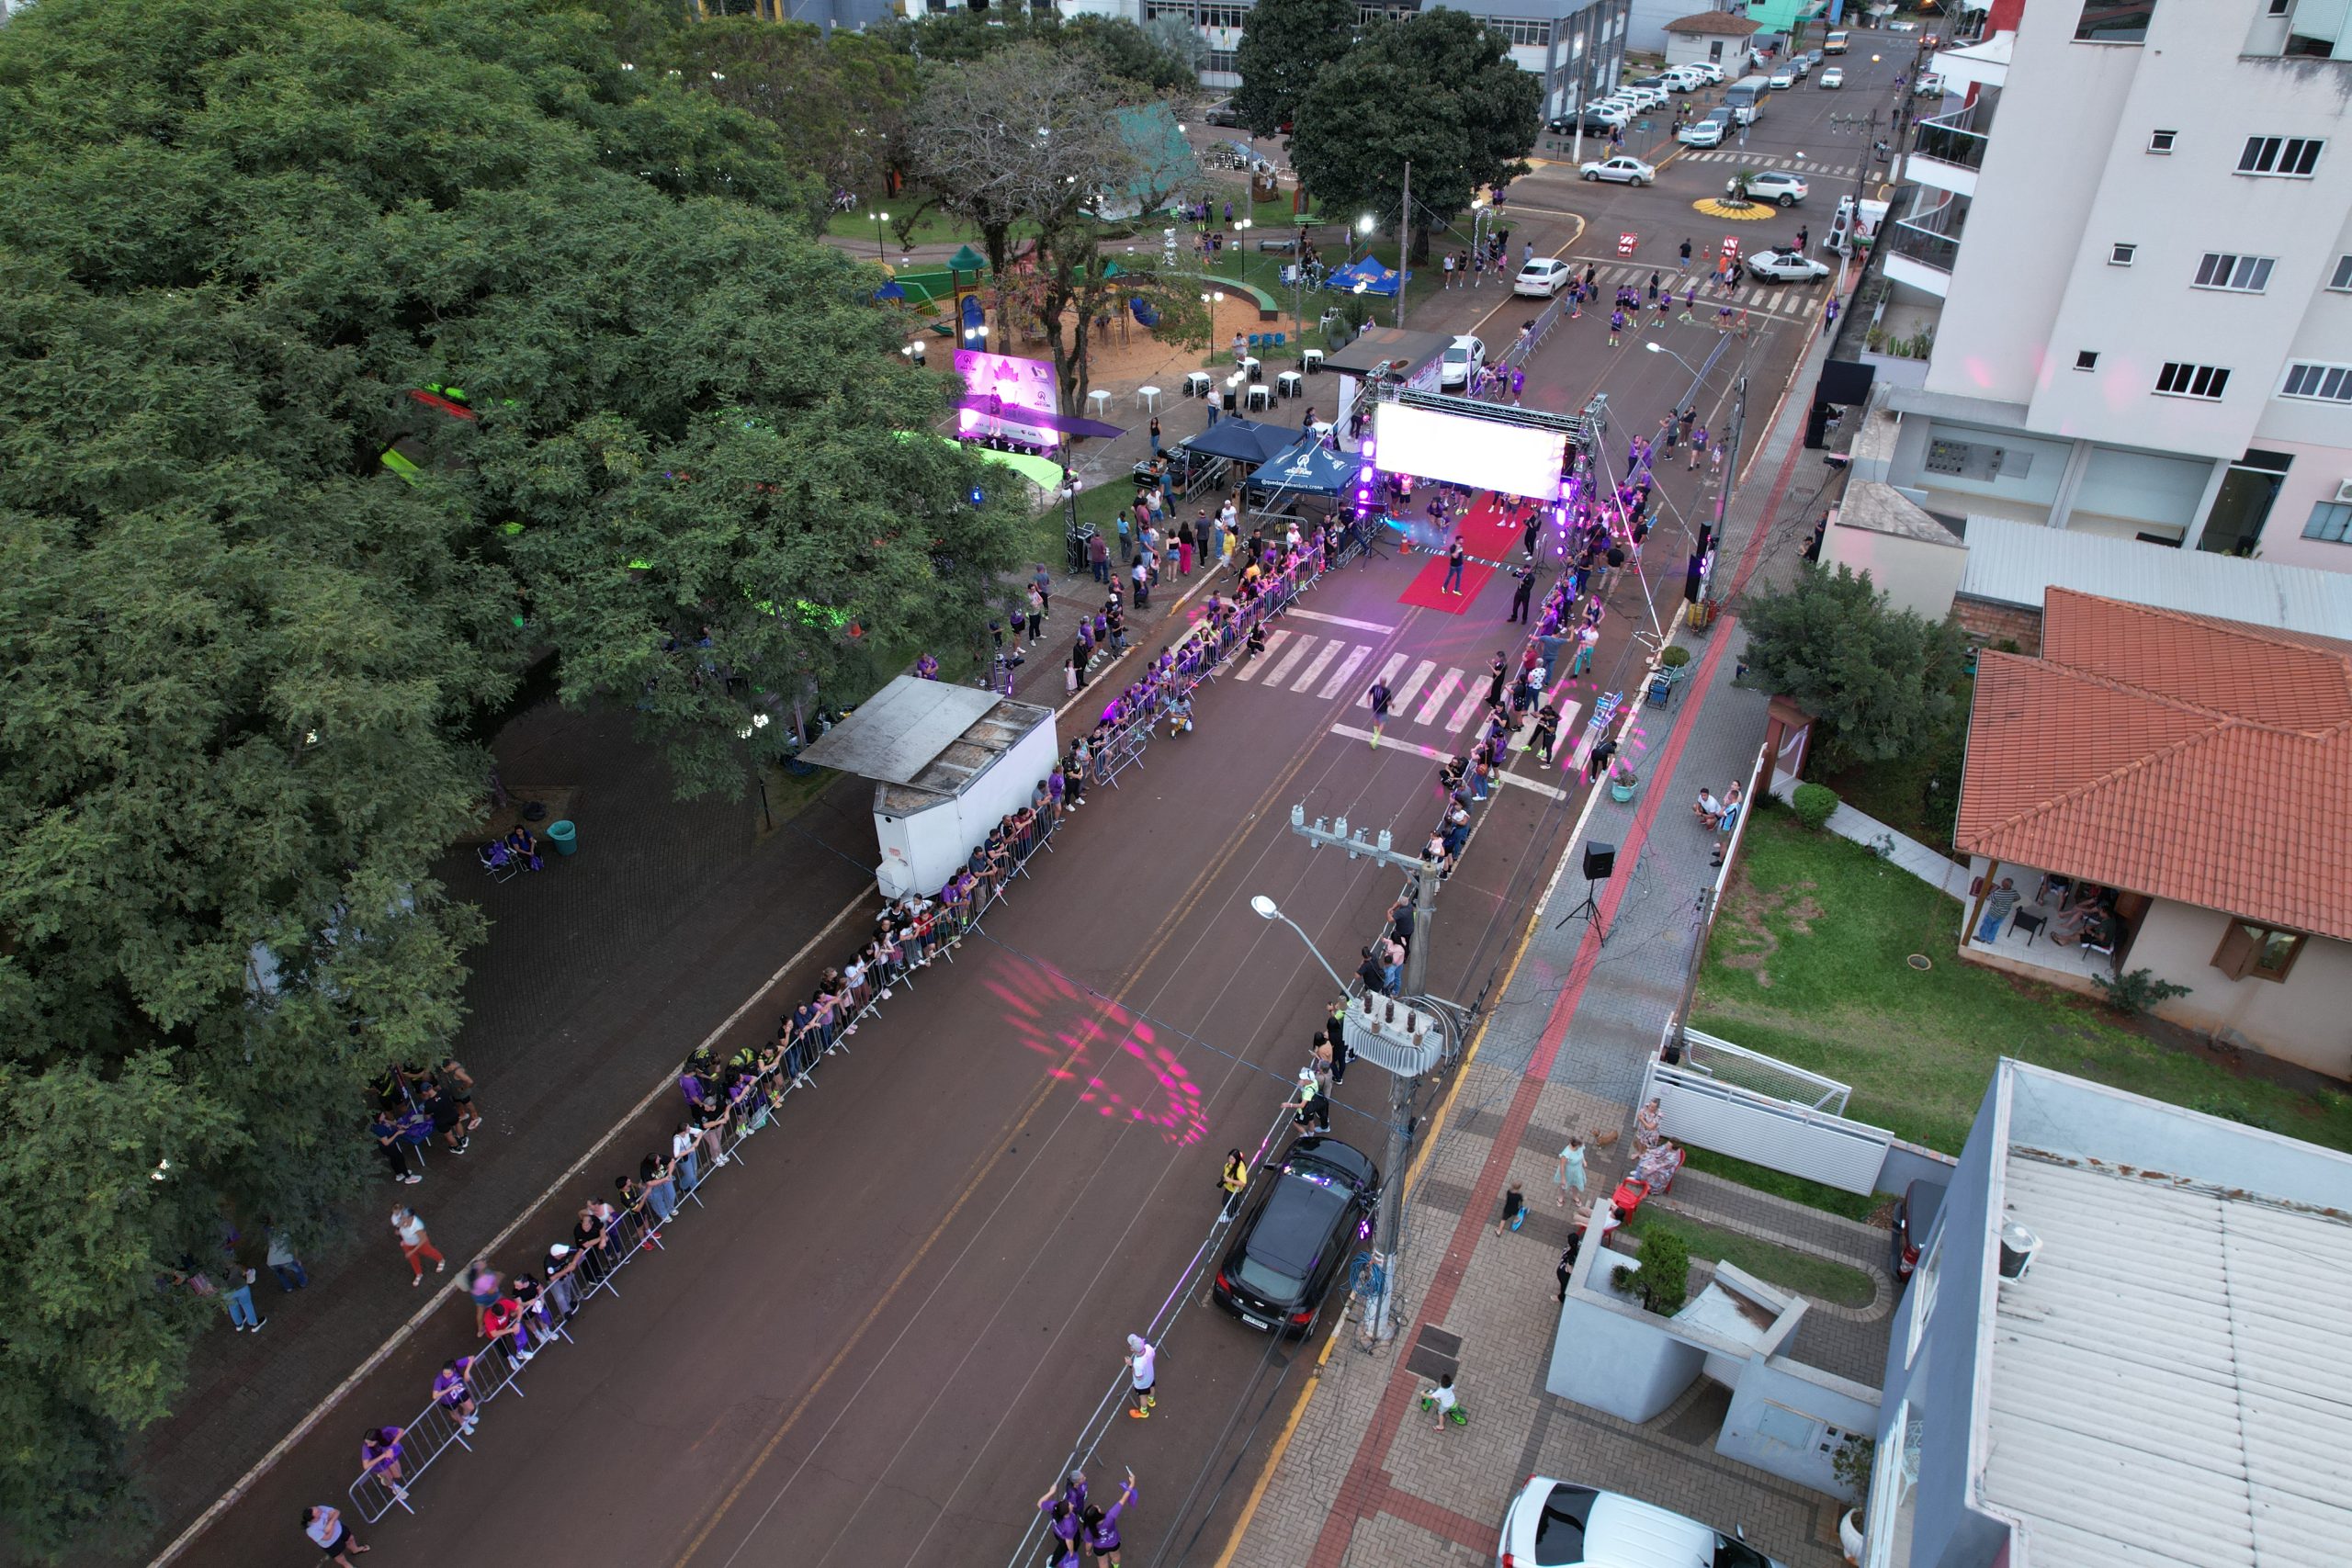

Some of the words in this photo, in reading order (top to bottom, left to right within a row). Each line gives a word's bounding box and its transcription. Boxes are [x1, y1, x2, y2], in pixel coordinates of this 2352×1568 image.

[990, 439, 998, 450] 1
[1007, 443, 1015, 452] 2
[1024, 446, 1032, 455] 4
